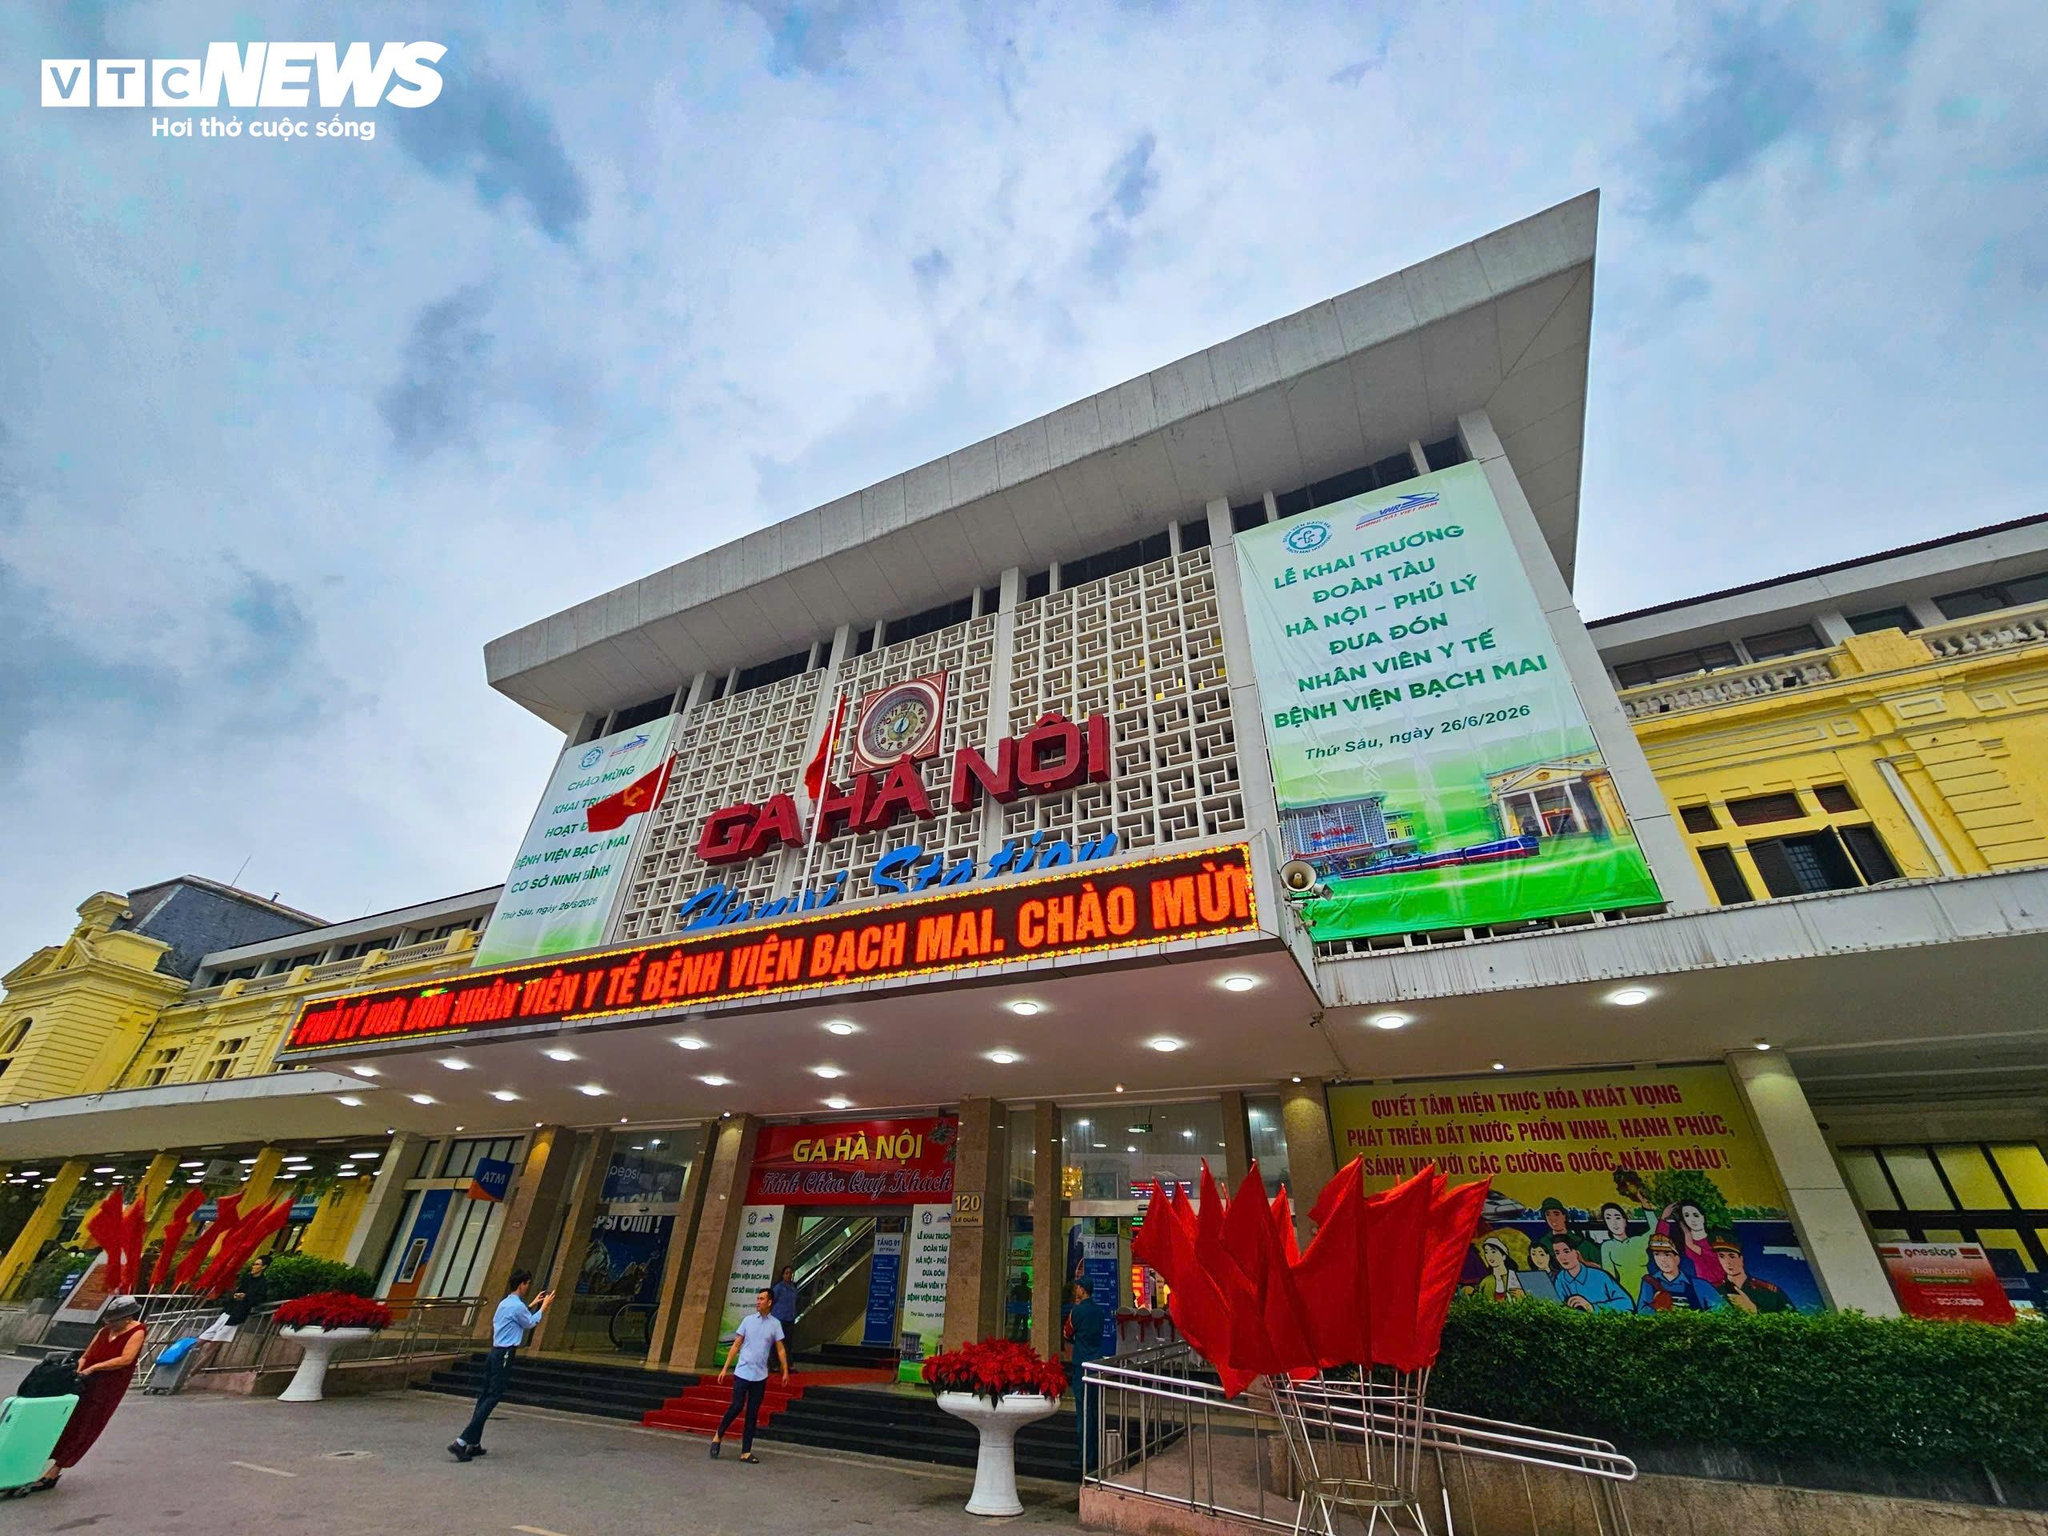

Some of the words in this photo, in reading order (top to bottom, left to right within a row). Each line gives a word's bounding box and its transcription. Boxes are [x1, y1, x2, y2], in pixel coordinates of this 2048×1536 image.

[1274, 559, 1297, 590] LỄ
[1302, 555, 1357, 582] KHAI
[1361, 524, 1465, 562] TRƯƠNG
[1312, 571, 1383, 603] ĐOÀN
[1387, 557, 1436, 585] TÀU
[1285, 609, 1318, 638] HÀ
[1323, 603, 1368, 630] NỘI
[1392, 581, 1445, 610] PHỦ
[1450, 573, 1479, 595] LÝ
[1329, 632, 1383, 656] ĐƯA
[1389, 612, 1449, 641] ĐÓN
[1297, 662, 1368, 693] NHÂN
[1371, 646, 1433, 675] VIÊN
[1438, 645, 1457, 660] Y
[1461, 627, 1496, 653] TẾ
[1273, 699, 1338, 729] BỆNH
[1342, 685, 1402, 714] VIỆN
[1408, 667, 1485, 701] BẠCH
[1493, 653, 1548, 681] MAI
[1304, 736, 1340, 761] Thứ
[1344, 735, 1384, 754] Sáu,
[1389, 724, 1435, 748] ngày
[1440, 704, 1531, 734] 26/6/2026
[567, 775, 600, 791] CHÀO
[601, 765, 635, 783] MỪNG
[697, 793, 805, 864] GA
[813, 753, 934, 842] HÀ
[951, 712, 1110, 812] NỘI
[552, 801, 579, 815] KHAI
[544, 823, 578, 838] HOẠT
[514, 854, 541, 870] BỆNH
[544, 848, 571, 863] VIỆN
[607, 834, 630, 849] MAI
[511, 880, 529, 893] CƠ
[530, 874, 550, 889] SỞ
[550, 873, 581, 886] NINH
[582, 864, 611, 881] BÌNH
[296, 999, 344, 1045] PHỦ
[335, 999, 369, 1040] LÝ
[450, 977, 521, 1025] NHÂN
[519, 969, 581, 1016] VIÊN
[583, 970, 605, 1008] Y
[605, 952, 647, 1006] TẾ
[641, 950, 724, 1004] BỆNH
[729, 933, 805, 990] VIỆN
[810, 922, 906, 980] BẠCH
[915, 909, 1004, 962] MAI.
[1018, 884, 1136, 948] CHÀO
[1372, 1093, 1417, 1119] QUYẾT
[1420, 1093, 1455, 1115] TÂM
[1457, 1091, 1495, 1117] HIỆN
[1497, 1090, 1541, 1114] THỰC
[1544, 1086, 1580, 1109] HÓA
[1582, 1083, 1628, 1107] KHÁT
[1630, 1084, 1683, 1109] VỌNG
[792, 1139, 829, 1163] GA
[833, 1131, 869, 1162] HÀ
[875, 1128, 923, 1165] NỘI
[1347, 1125, 1384, 1147] PHÁT
[1388, 1120, 1432, 1145] TRIỂN
[1435, 1120, 1465, 1144] ĐẤT
[1469, 1119, 1514, 1142] NƯỚC
[1518, 1115, 1566, 1141] PHỒN
[1567, 1119, 1618, 1141] VINH,
[1618, 1117, 1673, 1142] HẠNH
[1673, 1111, 1735, 1138] PHÚC,
[481, 1171, 506, 1185] ATM
[608, 1165, 640, 1181] pepsi
[1364, 1154, 1405, 1176] SÁNH
[1438, 1152, 1465, 1175] VỚI
[1468, 1152, 1502, 1175] CÁC
[1505, 1149, 1565, 1173] CƯỜNG
[1567, 1144, 1616, 1174] QUỐC
[1618, 1147, 1665, 1171] NĂM
[760, 1171, 800, 1195] Kính
[803, 1170, 845, 1194] Chào
[849, 1169, 888, 1200] Quý
[888, 1168, 952, 1193] Khách
[955, 1195, 981, 1212] 120
[1107, 1241, 1116, 1249] 01
